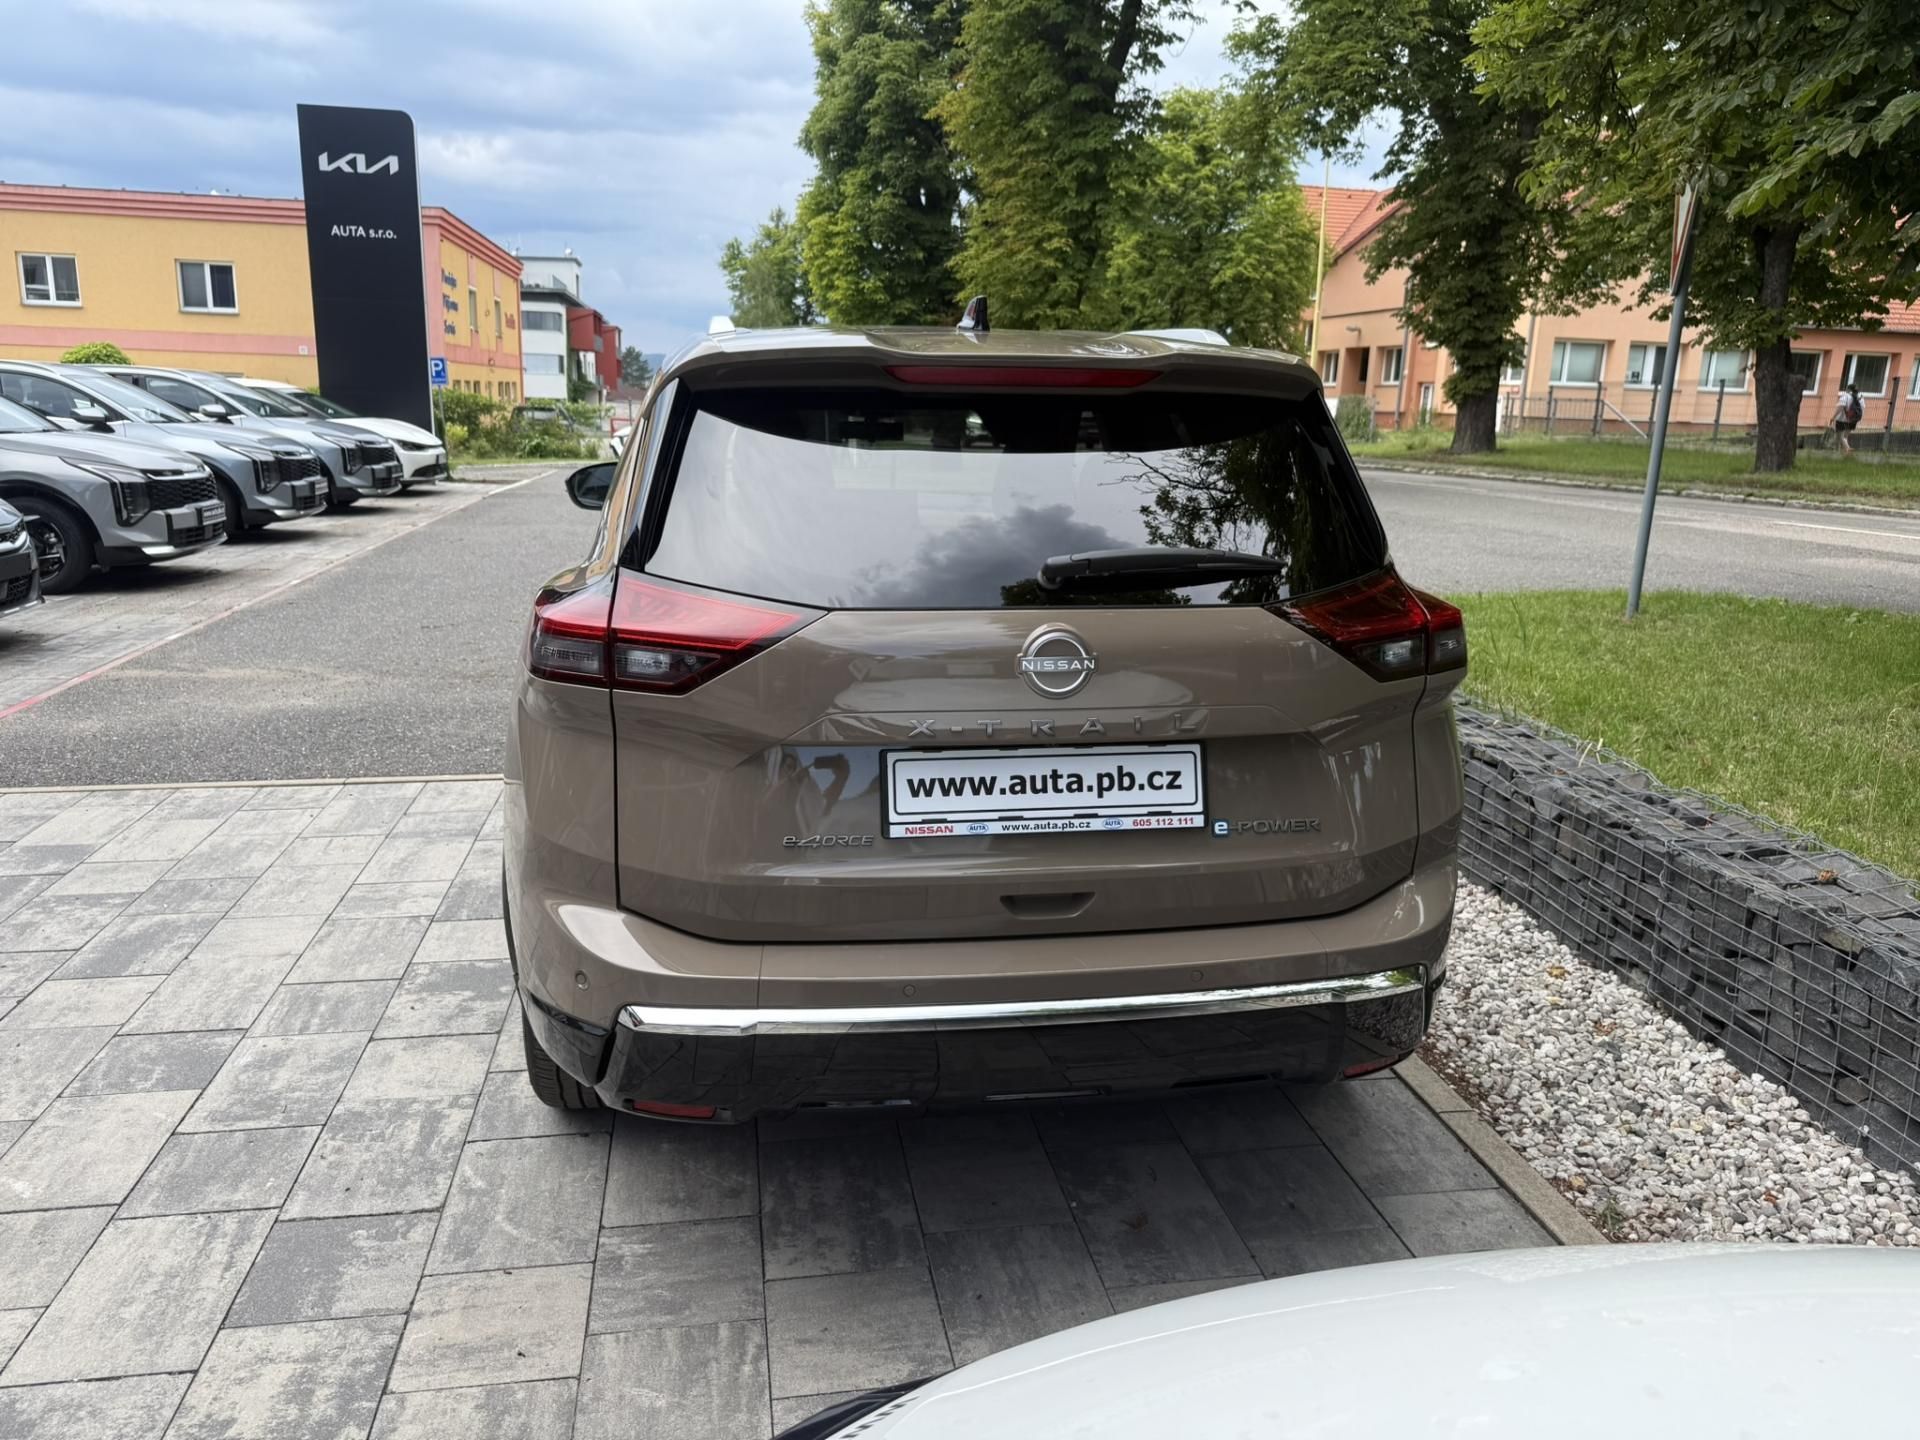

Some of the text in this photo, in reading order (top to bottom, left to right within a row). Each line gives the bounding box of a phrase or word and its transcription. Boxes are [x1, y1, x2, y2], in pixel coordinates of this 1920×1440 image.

[318, 151, 399, 176] KIA
[330, 224, 397, 239] AUTA s.r.o.
[431, 359, 443, 377] P
[1022, 659, 1095, 671] NISSAN
[908, 714, 1197, 738] X-TRAIL
[906, 764, 1183, 799] www.auta.pb.cz
[904, 824, 954, 836] NISSAN
[1001, 819, 1092, 832] www.auta.pb.cz
[1104, 819, 1122, 827] AUTA
[1132, 818, 1152, 827] 605
[1155, 817, 1174, 826] 112
[1177, 817, 1195, 825] 111
[1213, 817, 1321, 836] e-POWER
